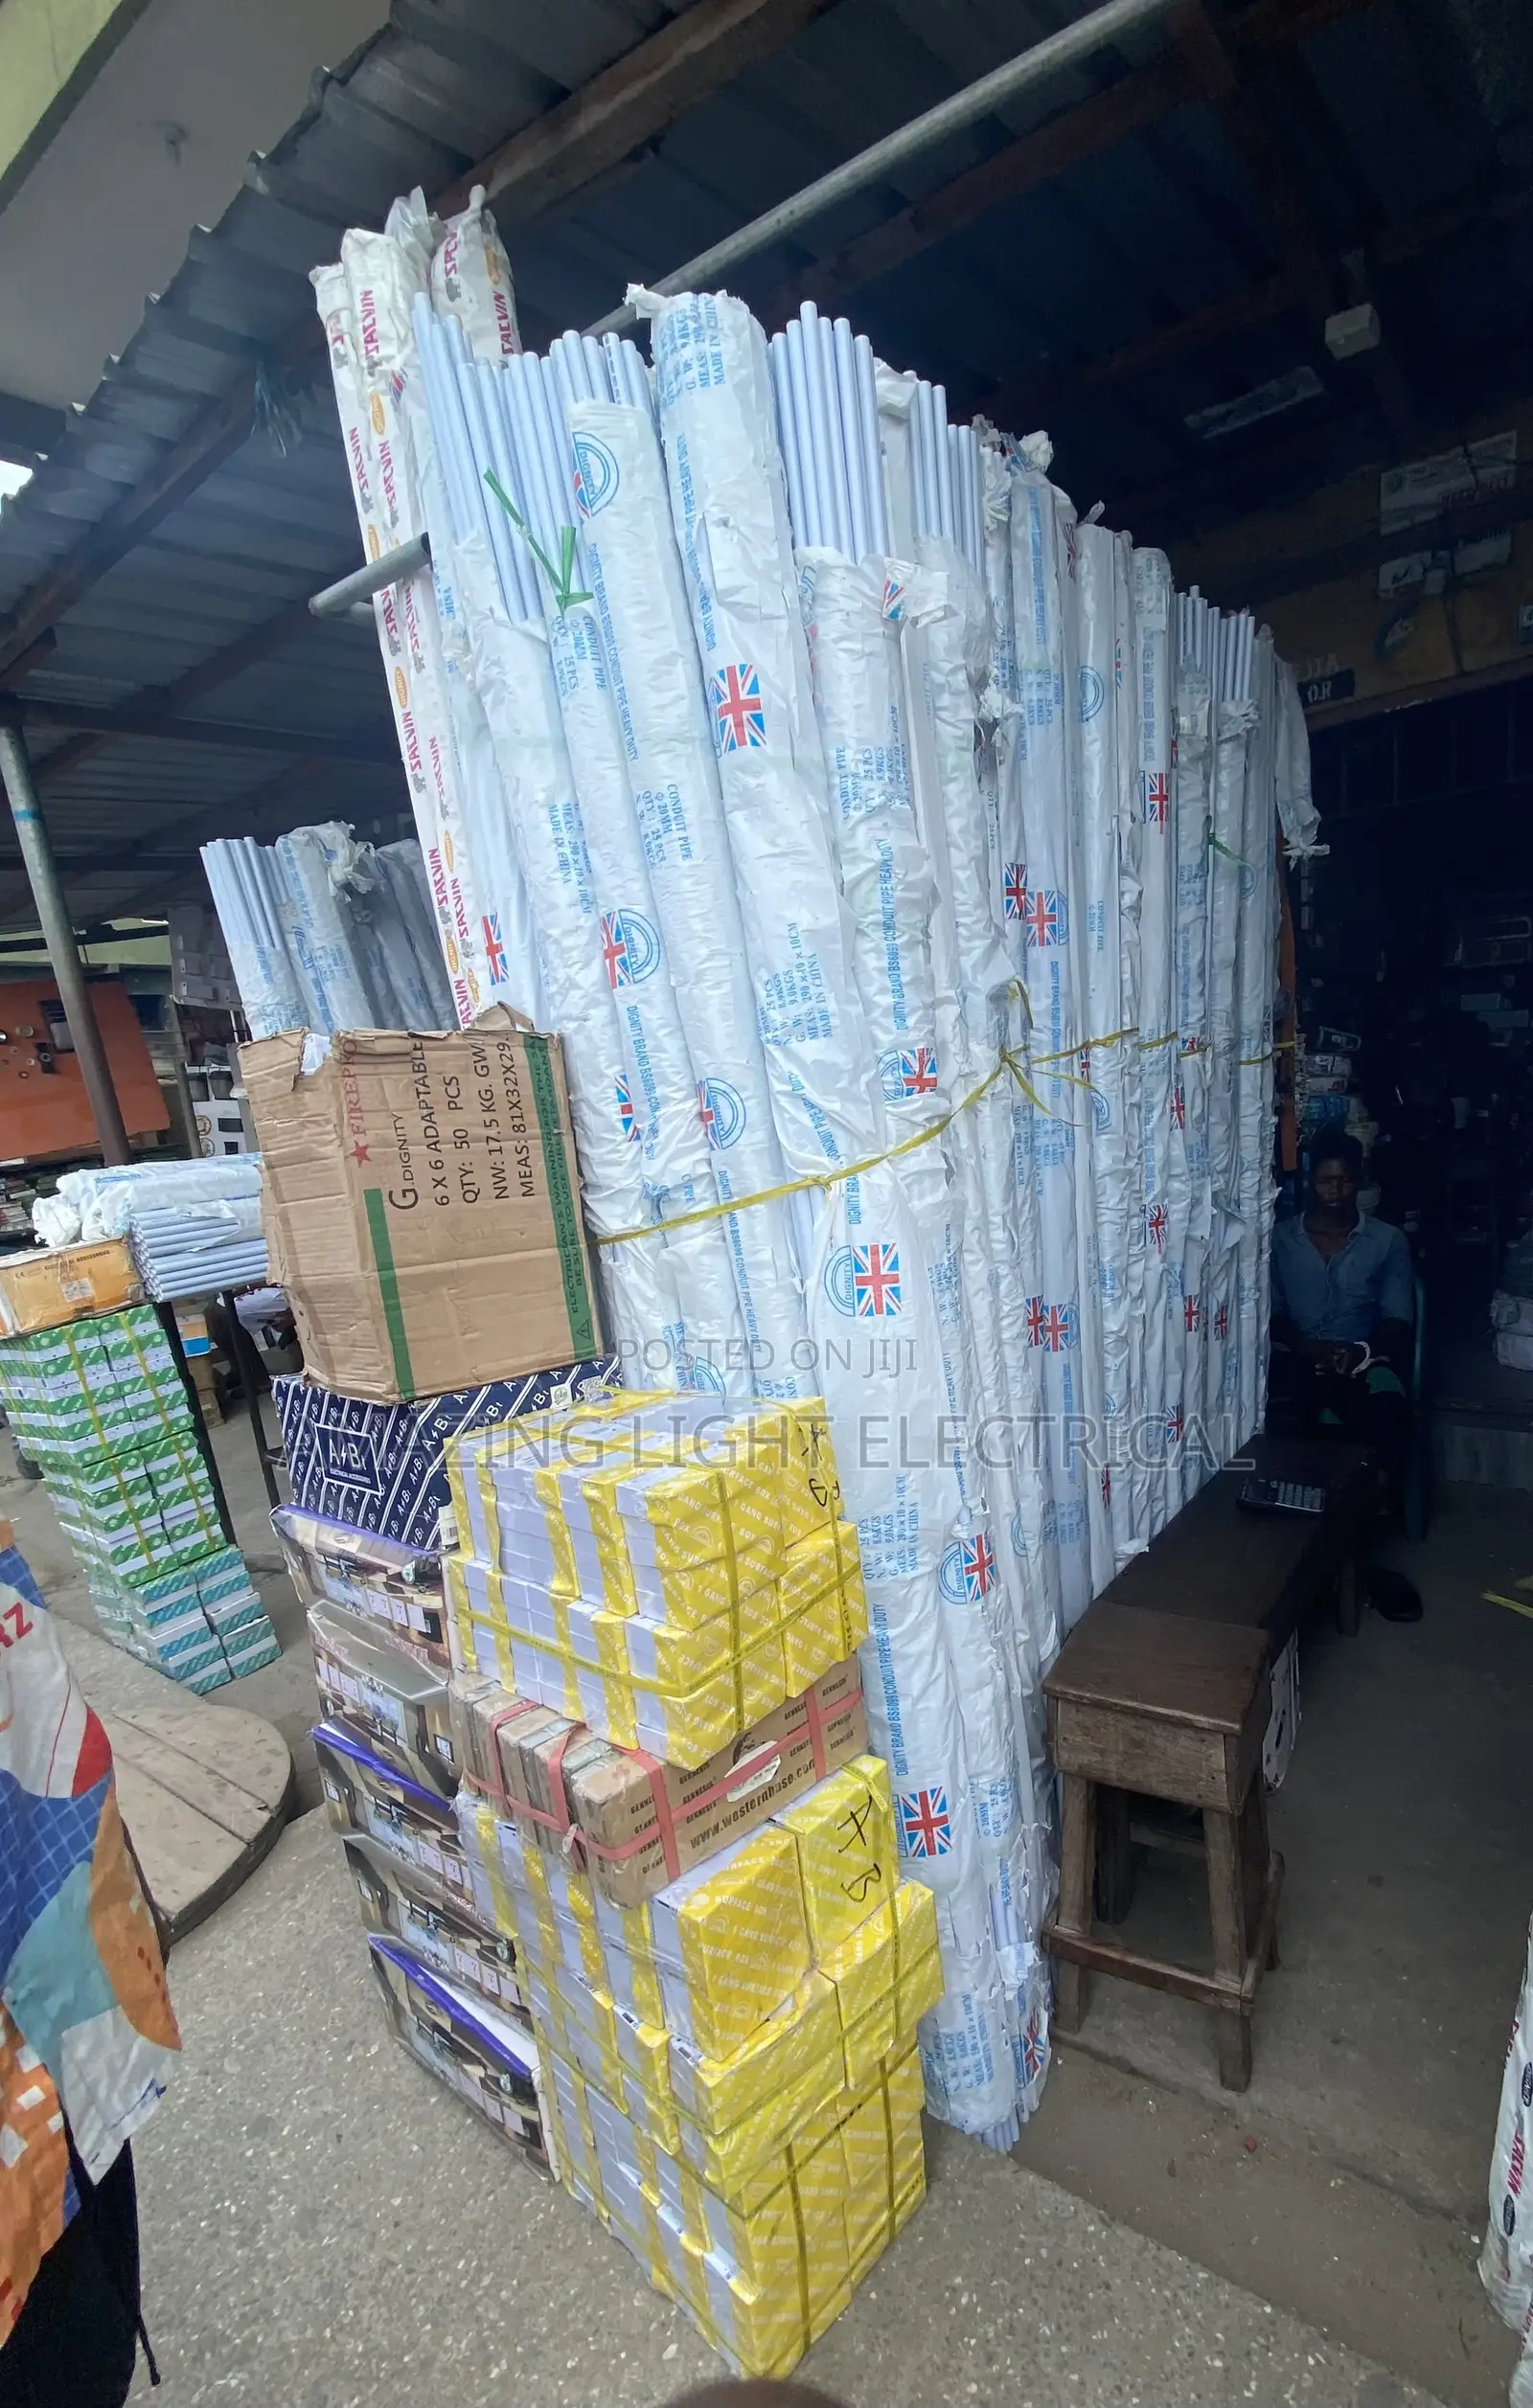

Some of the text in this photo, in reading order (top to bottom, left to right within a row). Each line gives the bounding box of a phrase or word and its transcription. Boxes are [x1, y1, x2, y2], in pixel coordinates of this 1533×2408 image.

[709, 335, 725, 386] MADE IN
[579, 450, 597, 496] DIGNITY
[679, 460, 693, 490] HEAVY
[586, 542, 603, 581] DIGNITY
[592, 581, 608, 614] BRAND
[701, 615, 718, 650] DIGNITY
[592, 661, 606, 691] PIPE
[604, 647, 623, 685] CONDUIT
[613, 686, 628, 708] PIPE
[618, 709, 633, 735] HEAVY
[624, 737, 639, 761] DUTY
[835, 747, 847, 771] PIPE
[548, 805, 563, 834] MADE
[657, 803, 673, 833] 20MM
[667, 784, 693, 861] CONDUIT PIPE
[651, 829, 667, 863] 25 PCS
[878, 858, 892, 884] HEAVY
[880, 885, 894, 904] PIPE
[787, 922, 801, 948] 10CM
[881, 904, 897, 943] CONDUIT
[623, 925, 640, 965] DIGNITY
[786, 969, 798, 1005] 9.0KGS
[802, 985, 812, 1002] 290
[815, 993, 826, 1007] IN
[888, 972, 904, 999] BRAND
[626, 1005, 642, 1037] DIGNITY
[817, 1012, 834, 1039] MADE
[892, 999, 909, 1030] DIGNITY
[631, 1037, 648, 1066] BRAND
[535, 1064, 544, 1093] THE
[477, 1084, 495, 1112] KG.
[539, 1095, 550, 1128] FOR
[412, 1041, 450, 1206] 6 X 6 ADAPTABLE
[710, 1093, 727, 1134] DIGNITY
[808, 1108, 829, 1130] PIPE
[444, 1076, 480, 1204] QTY: 50 PCS
[484, 1119, 503, 1156] 17.5
[817, 1126, 843, 1161] CONDUIT
[490, 1161, 509, 1200] NW:
[515, 1140, 536, 1197] MEAS:
[545, 1132, 561, 1206] WARNING
[560, 1172, 570, 1200] USE
[718, 1170, 731, 1200] DIGNITY
[845, 1174, 862, 1225] DIGNITY BRA
[564, 1207, 573, 1224] TO
[569, 1233, 581, 1265] SURE
[575, 1269, 583, 1286] BE
[734, 1257, 748, 1290] CONDUIT
[844, 1261, 853, 1301] DIGNITY
[741, 1290, 752, 1307] PIPE
[744, 1307, 758, 1333] HEAVY
[749, 1333, 763, 1354] DUTY
[674, 1518, 690, 1533] BOX
[740, 1502, 764, 1521] GANG
[739, 1527, 757, 1542] BOX
[909, 1501, 920, 1570] MADE IN CHINA
[703, 1588, 727, 1605] GANG
[871, 1602, 888, 1623] DUTY
[874, 1623, 891, 1647] HEAVY
[878, 1647, 893, 1664] PIPE
[879, 1663, 897, 1694] CONDUIT
[887, 1722, 904, 1748] BRAND
[892, 1747, 909, 1776] DIGNITY
